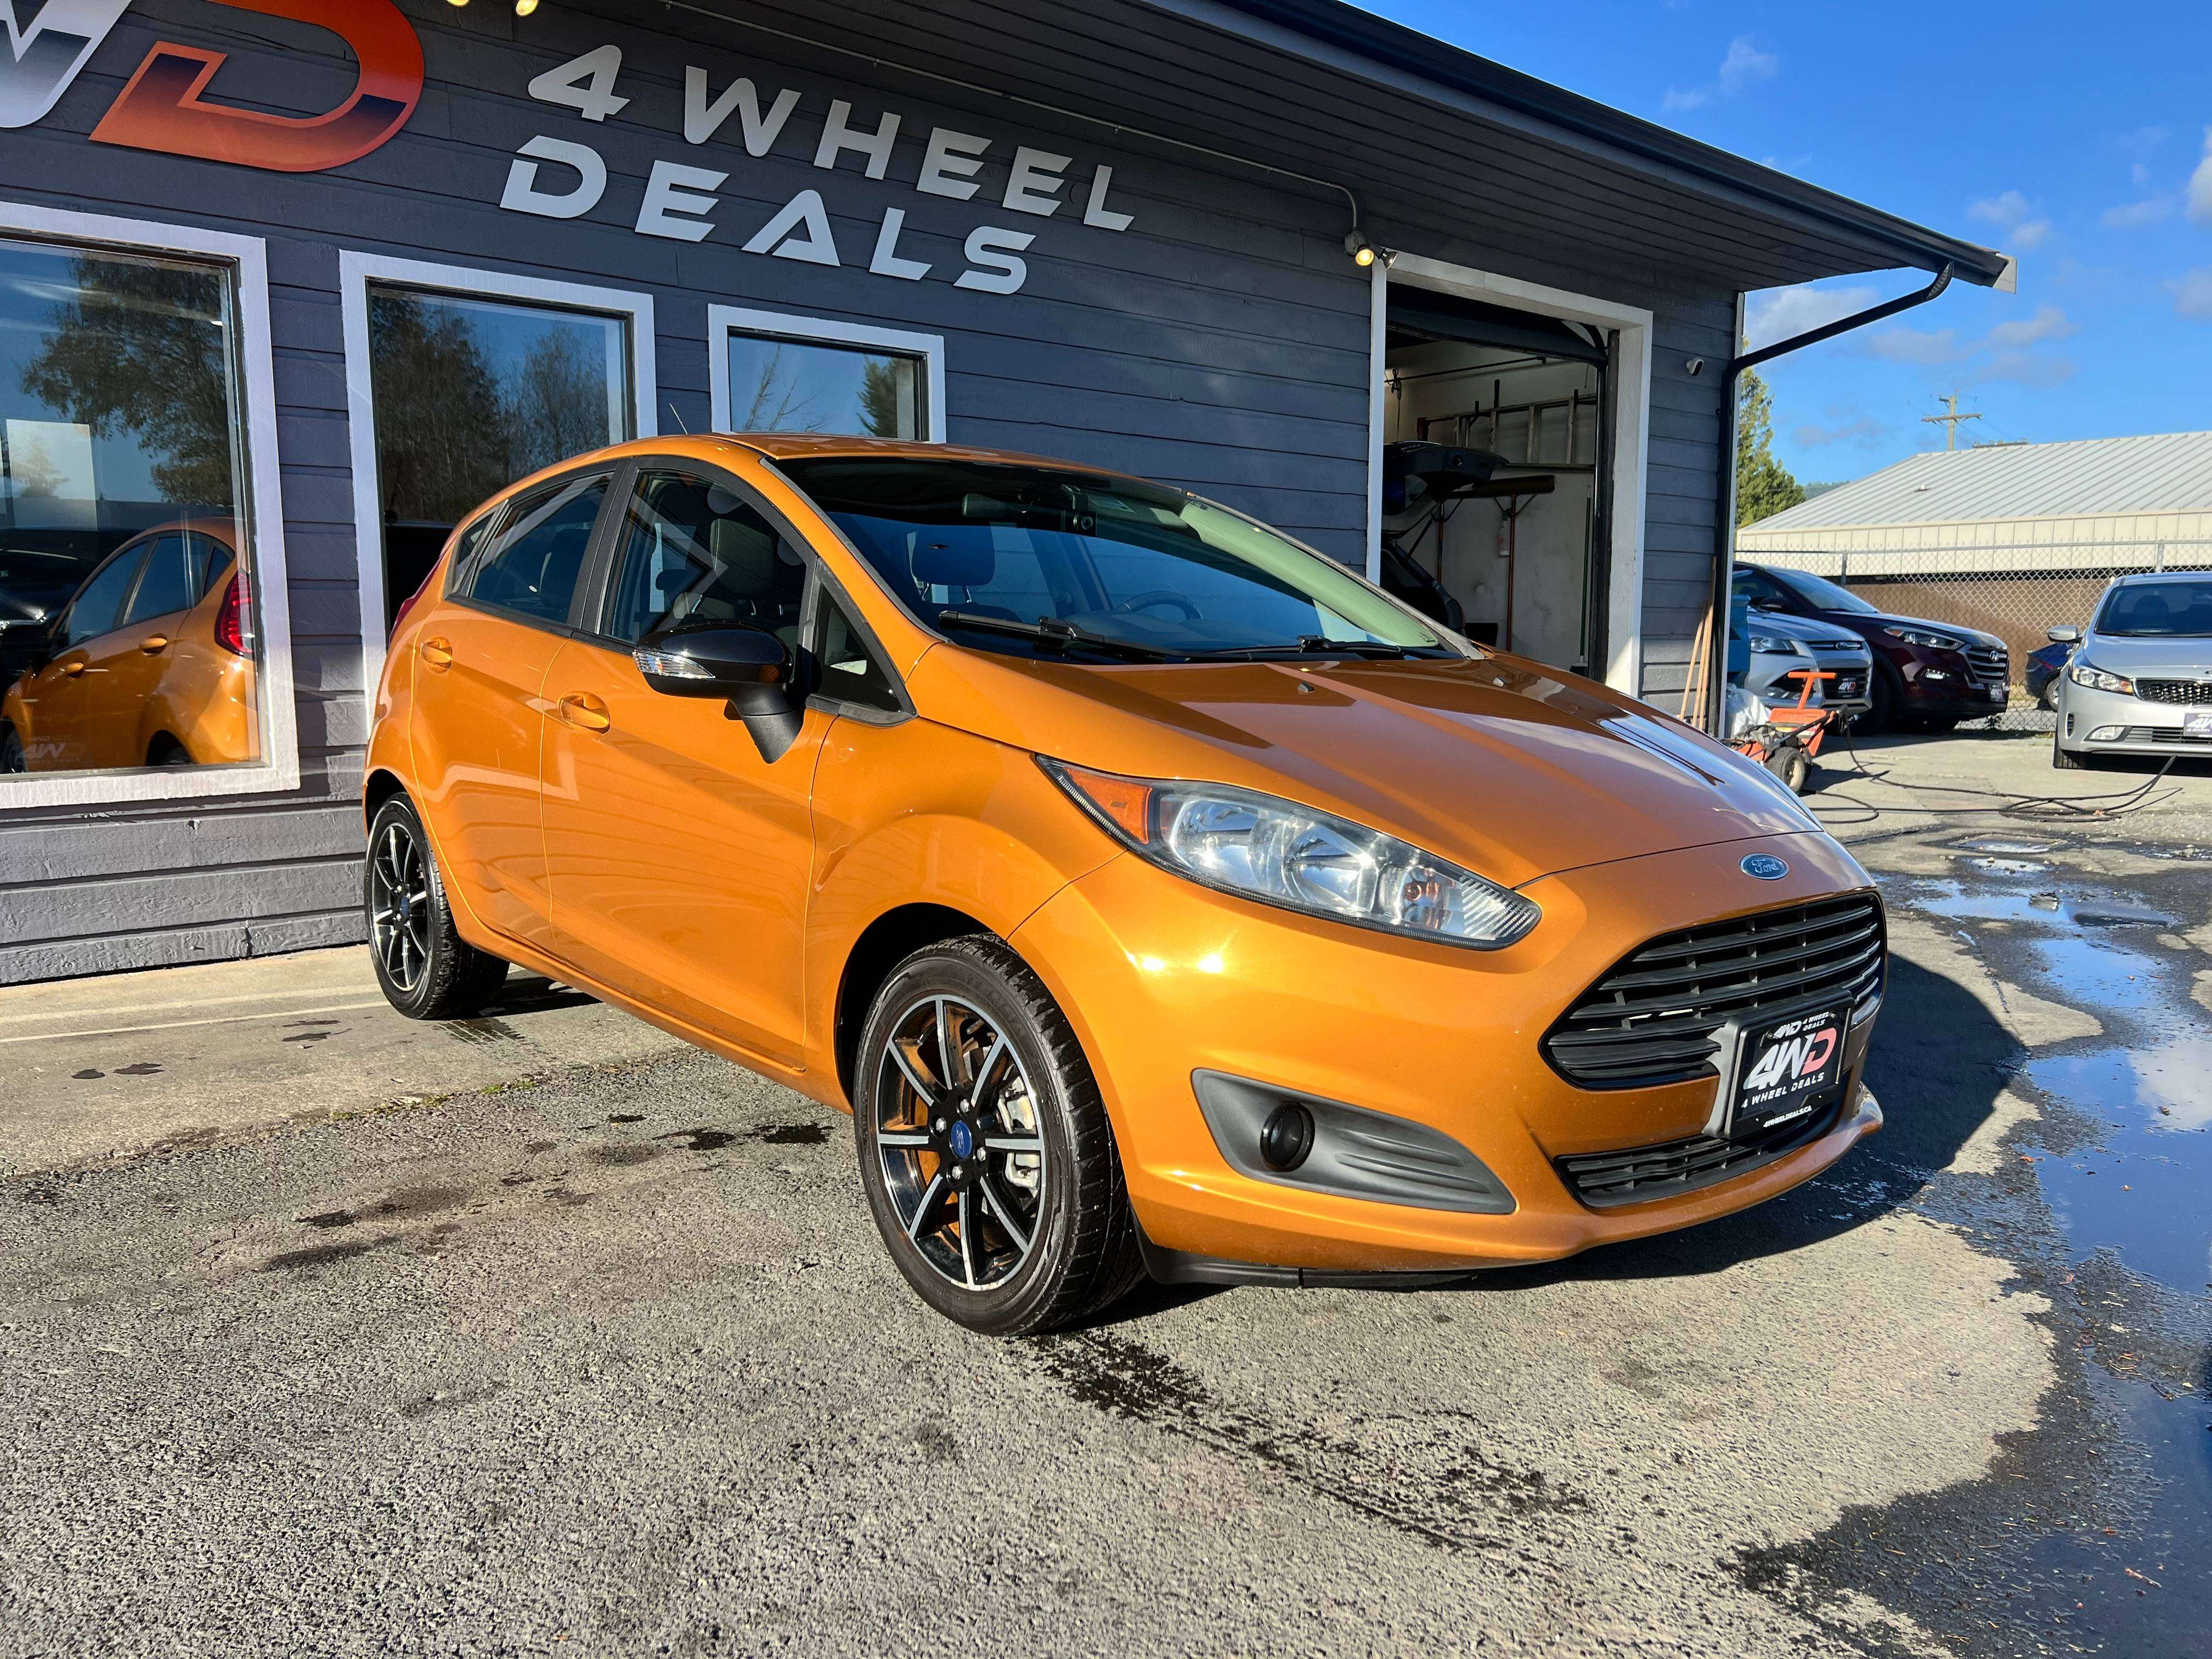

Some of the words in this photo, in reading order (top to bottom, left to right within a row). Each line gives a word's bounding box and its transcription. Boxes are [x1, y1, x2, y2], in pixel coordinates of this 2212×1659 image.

[527, 44, 630, 122] 4
[684, 65, 1135, 232] WHEEL
[499, 134, 1036, 296] DEALS
[1751, 859, 1779, 874] Ford
[1772, 1020, 1802, 1040] 4WD
[1802, 1019, 1826, 1031] DEALS
[1743, 1027, 1837, 1091] 4WD
[1741, 1098, 1748, 1109] 4
[1751, 1086, 1787, 1105] WHEEL
[1791, 1071, 1825, 1092] DEALS
